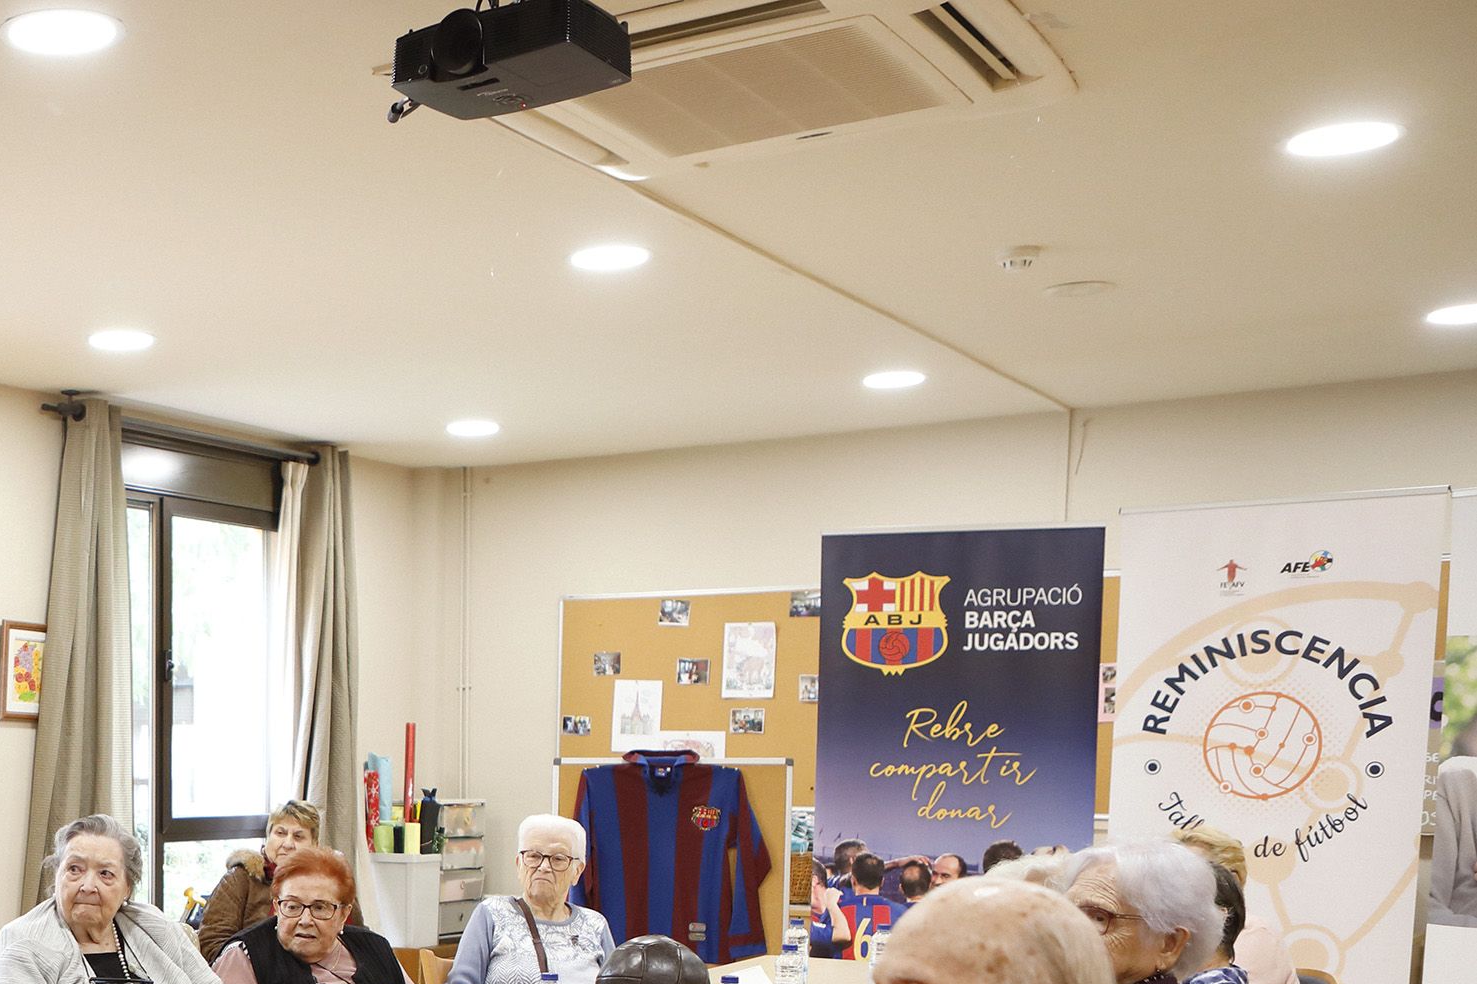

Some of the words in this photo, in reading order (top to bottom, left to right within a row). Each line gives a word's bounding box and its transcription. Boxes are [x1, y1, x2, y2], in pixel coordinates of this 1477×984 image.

[1280, 562, 1310, 574] AFE
[964, 583, 1083, 607] AGRUPACIÓ
[964, 610, 1035, 634] BARÇA
[962, 631, 1079, 652] JUGADORS
[1142, 629, 1394, 738] REMINISCENCIA
[903, 700, 1006, 748] Rebre
[917, 780, 1012, 829] donar
[1253, 835, 1287, 858] de
[1294, 793, 1368, 863] fútbol
